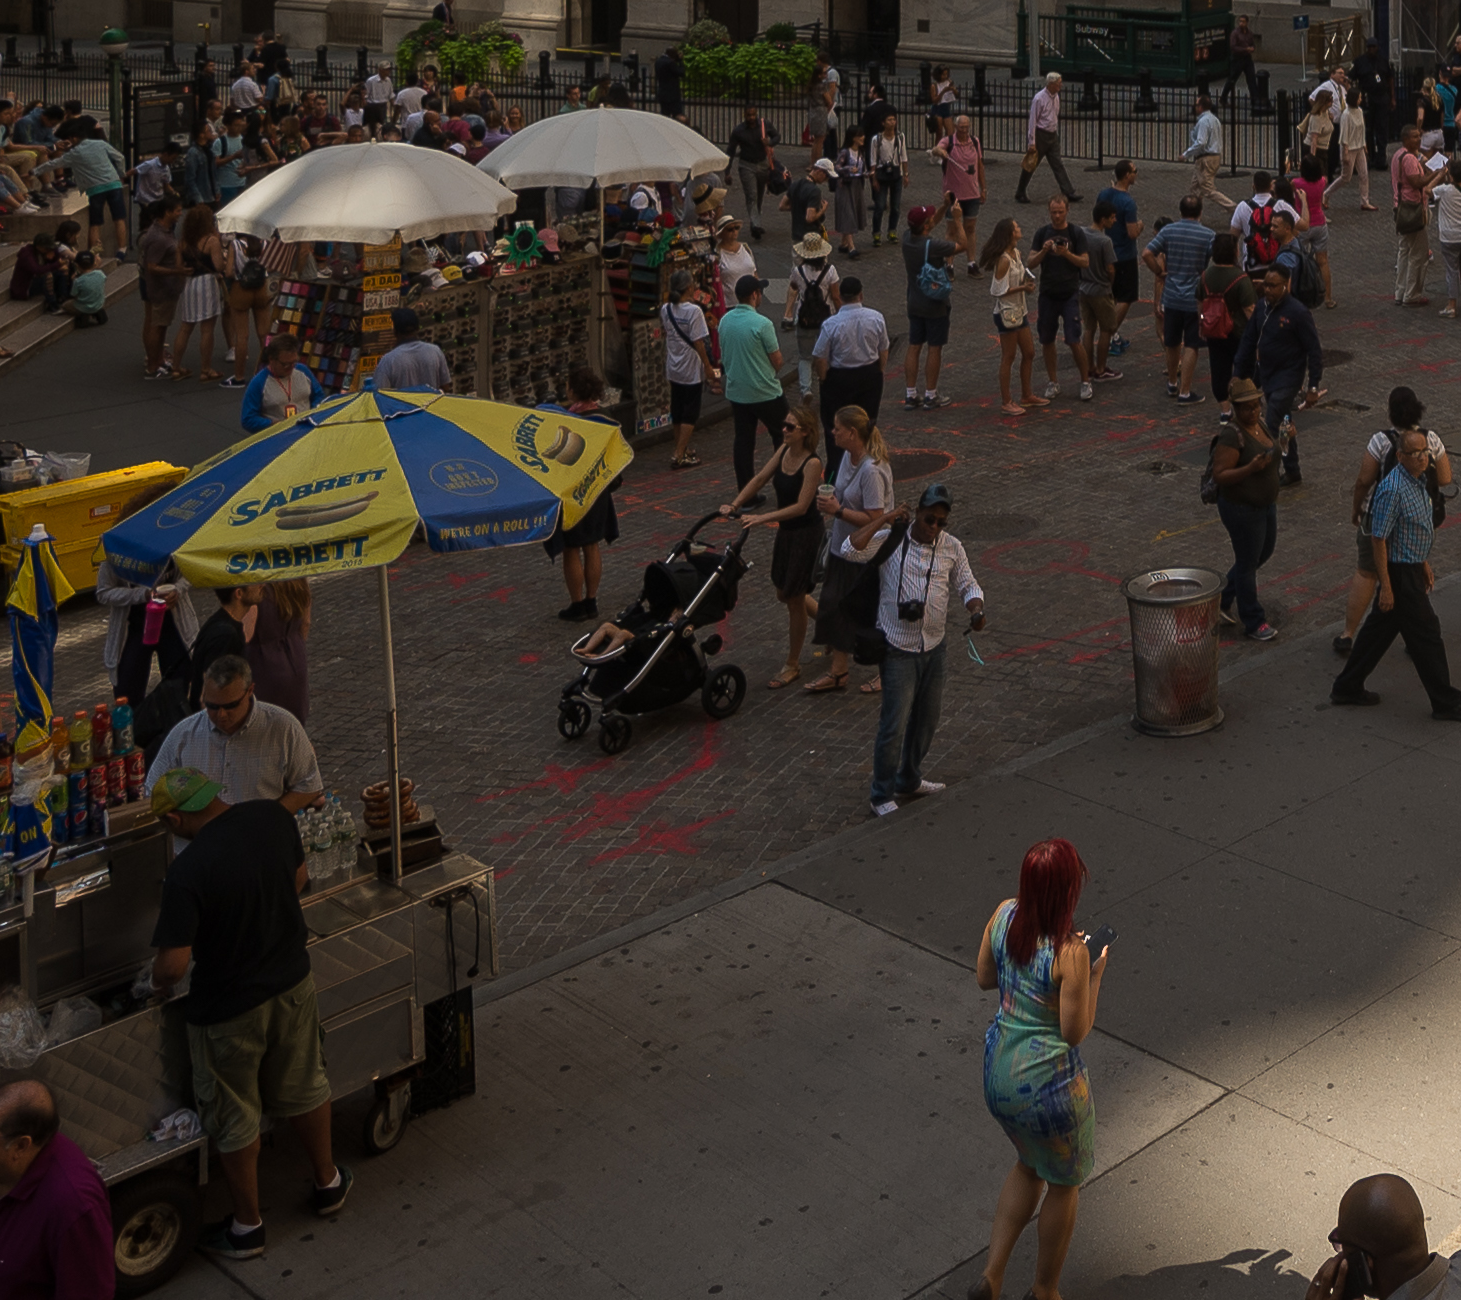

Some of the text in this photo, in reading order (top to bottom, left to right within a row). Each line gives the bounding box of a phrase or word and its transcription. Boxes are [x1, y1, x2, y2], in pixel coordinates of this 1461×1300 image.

[1075, 23, 1109, 37] Subway
[379, 274, 400, 286] DAD
[513, 413, 549, 474] SABRETT
[228, 468, 387, 527] SABRETT
[474, 524, 490, 536] ON
[492, 522, 501, 533] A
[503, 519, 530, 533] ROLL
[226, 535, 370, 574] SABRETT
[341, 558, 364, 569] 2015
[20, 825, 37, 843] ON
